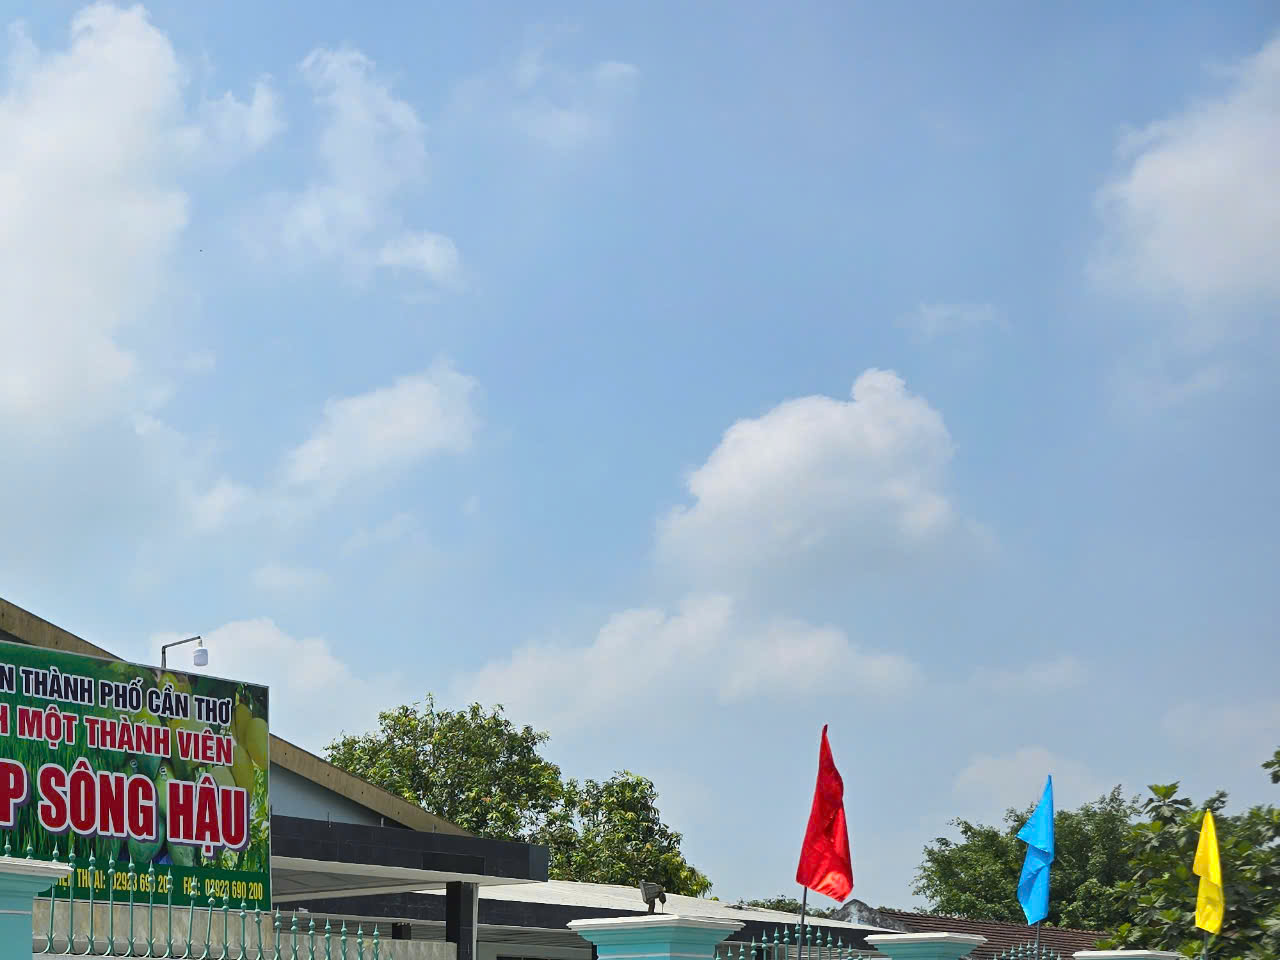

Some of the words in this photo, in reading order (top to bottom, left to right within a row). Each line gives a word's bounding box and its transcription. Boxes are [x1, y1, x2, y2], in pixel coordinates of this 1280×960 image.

[20, 667, 94, 704] THÀNH
[100, 677, 143, 711] PHỐ
[148, 683, 189, 718] CẦN
[195, 696, 232, 724] THƠ
[17, 705, 78, 748] MỘT
[84, 716, 171, 757] THÀNH
[177, 729, 233, 765] VIÊN
[38, 759, 156, 840] SÔNG
[167, 774, 247, 855] HẬU
[158, 874, 173, 894] 20
[232, 880, 247, 899] 690
[248, 882, 263, 901] 200
